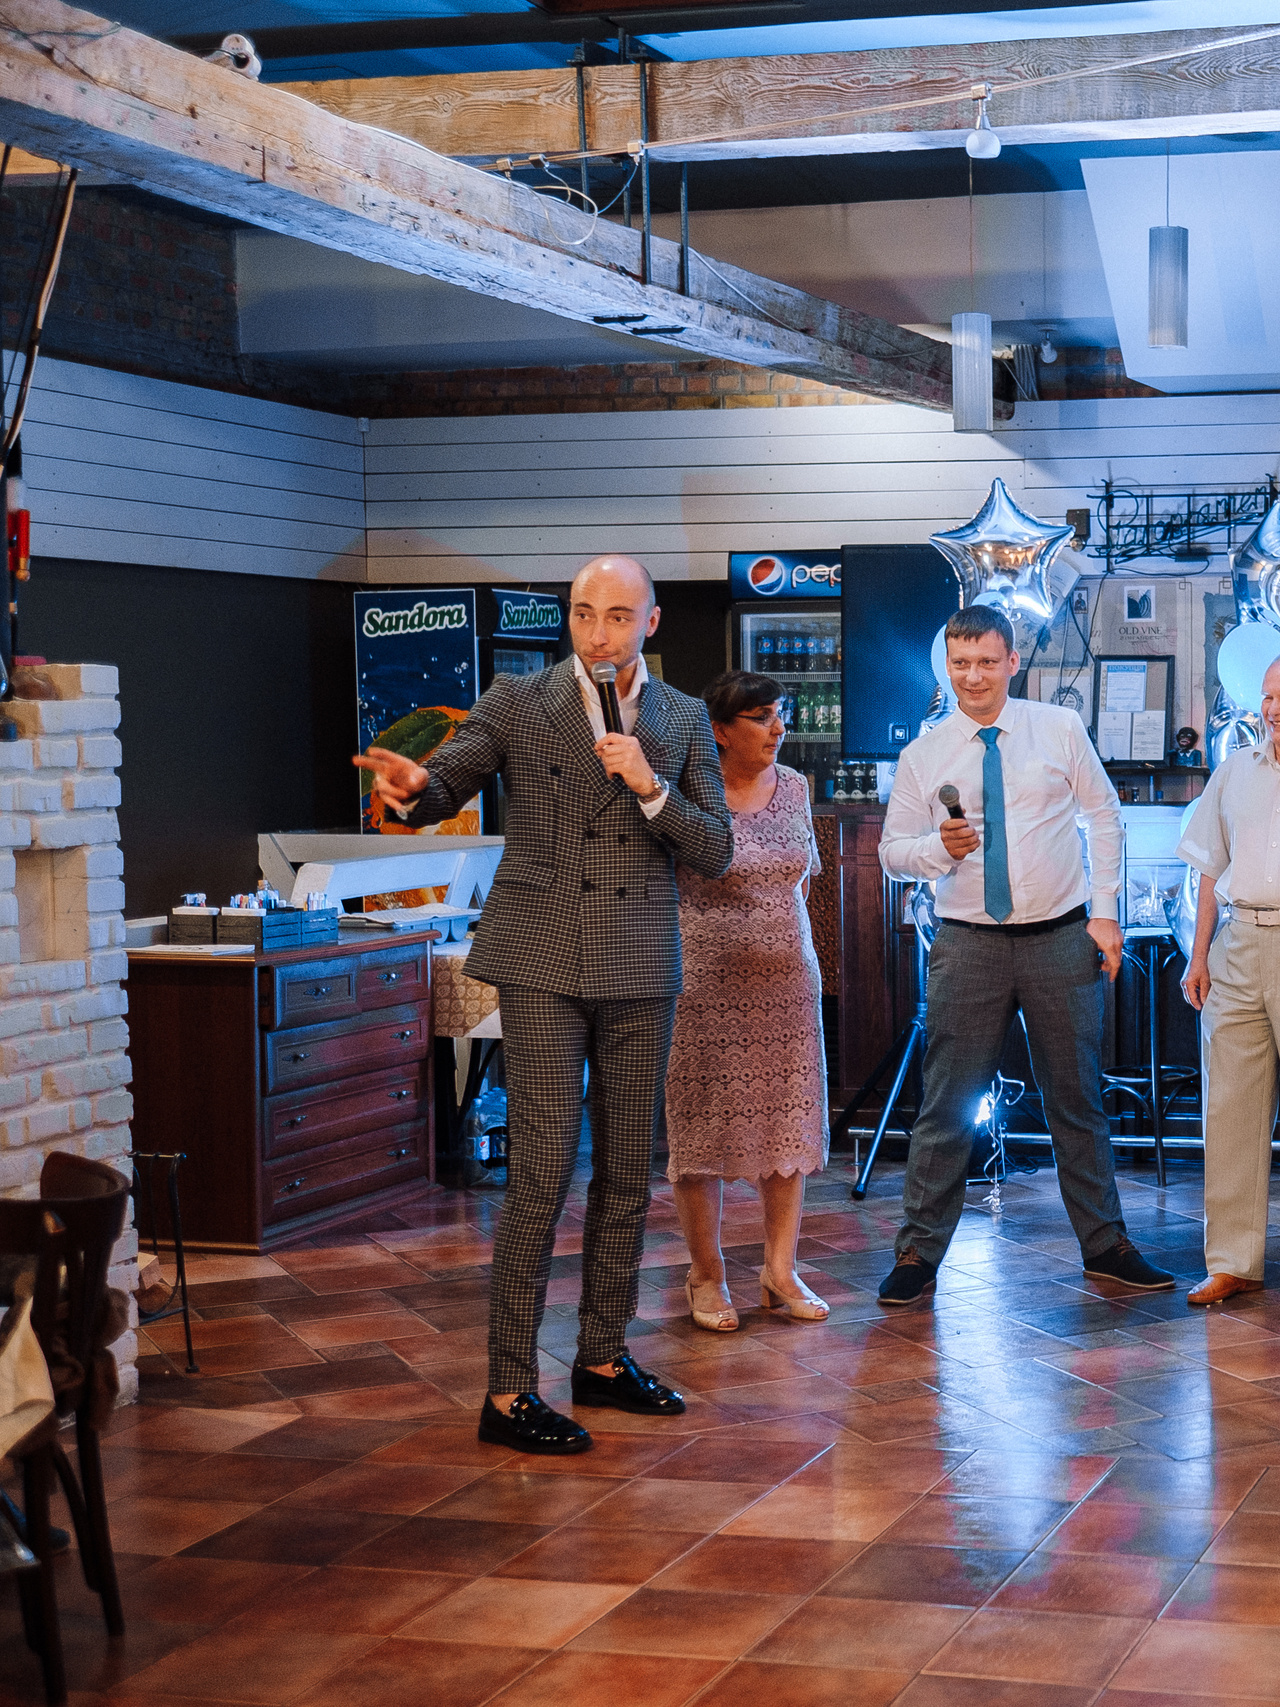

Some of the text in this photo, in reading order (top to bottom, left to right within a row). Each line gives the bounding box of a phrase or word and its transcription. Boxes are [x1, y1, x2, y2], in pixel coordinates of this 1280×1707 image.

[791, 564, 841, 588] pep
[363, 602, 467, 637] Sandora
[501, 599, 561, 630] Sandora
[1118, 627, 1162, 635] OLD VINE
